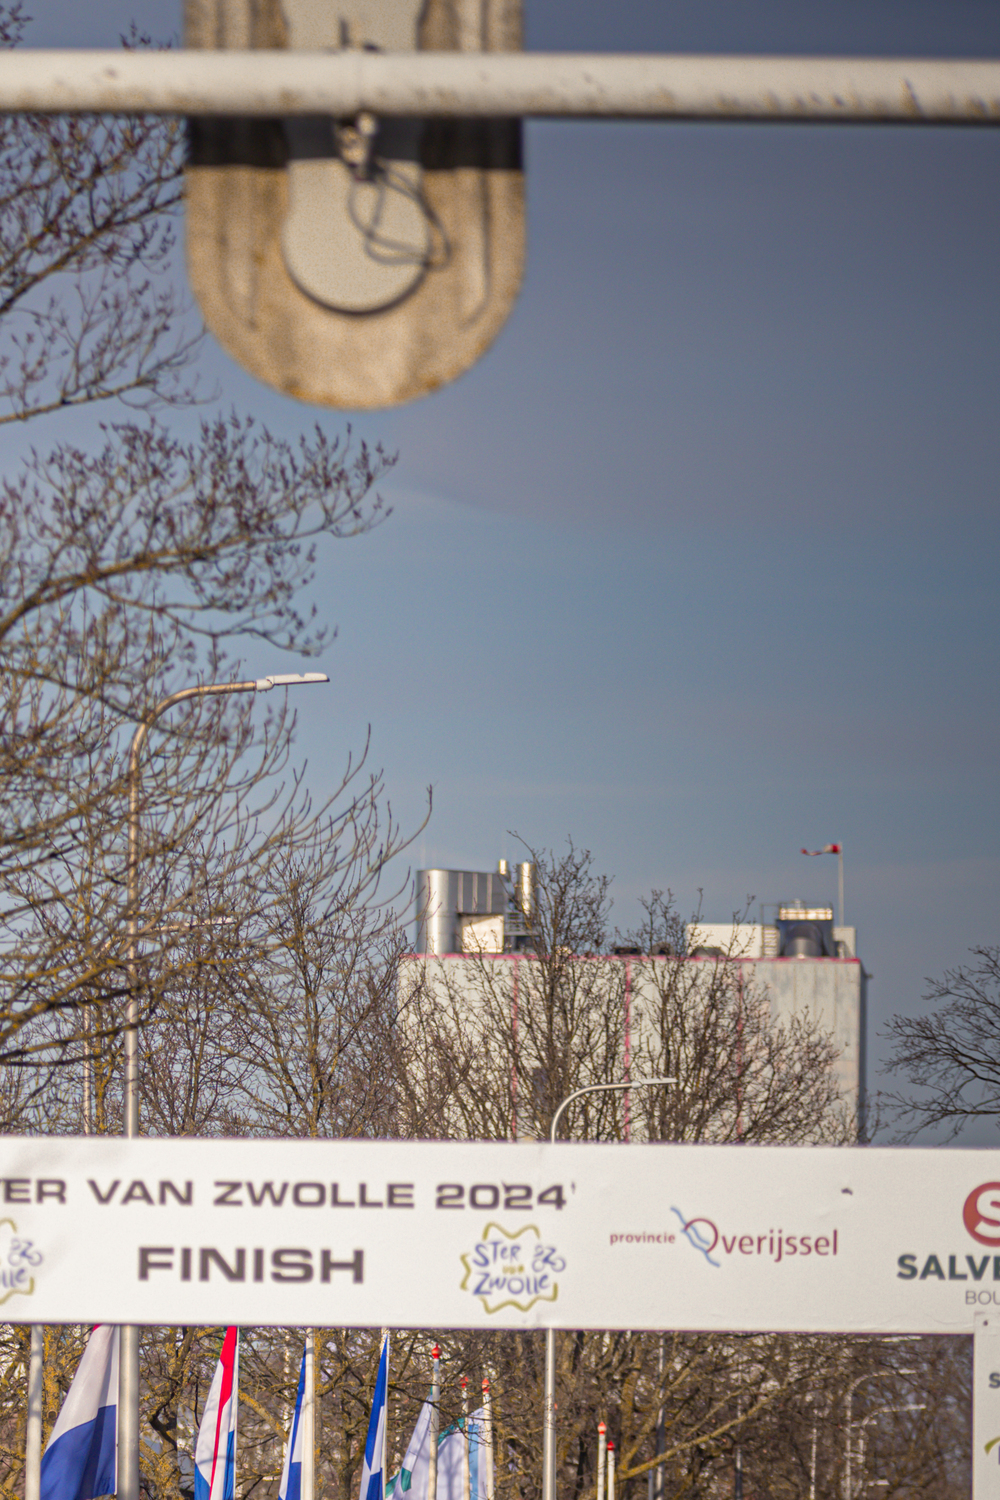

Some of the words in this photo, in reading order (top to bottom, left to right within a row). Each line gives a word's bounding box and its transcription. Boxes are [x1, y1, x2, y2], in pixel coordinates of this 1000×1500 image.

[87, 1179, 193, 1205] VAN
[213, 1181, 415, 1208] ZWOLLE
[610, 1230, 676, 1246] provincie
[138, 1247, 364, 1283] FINISH
